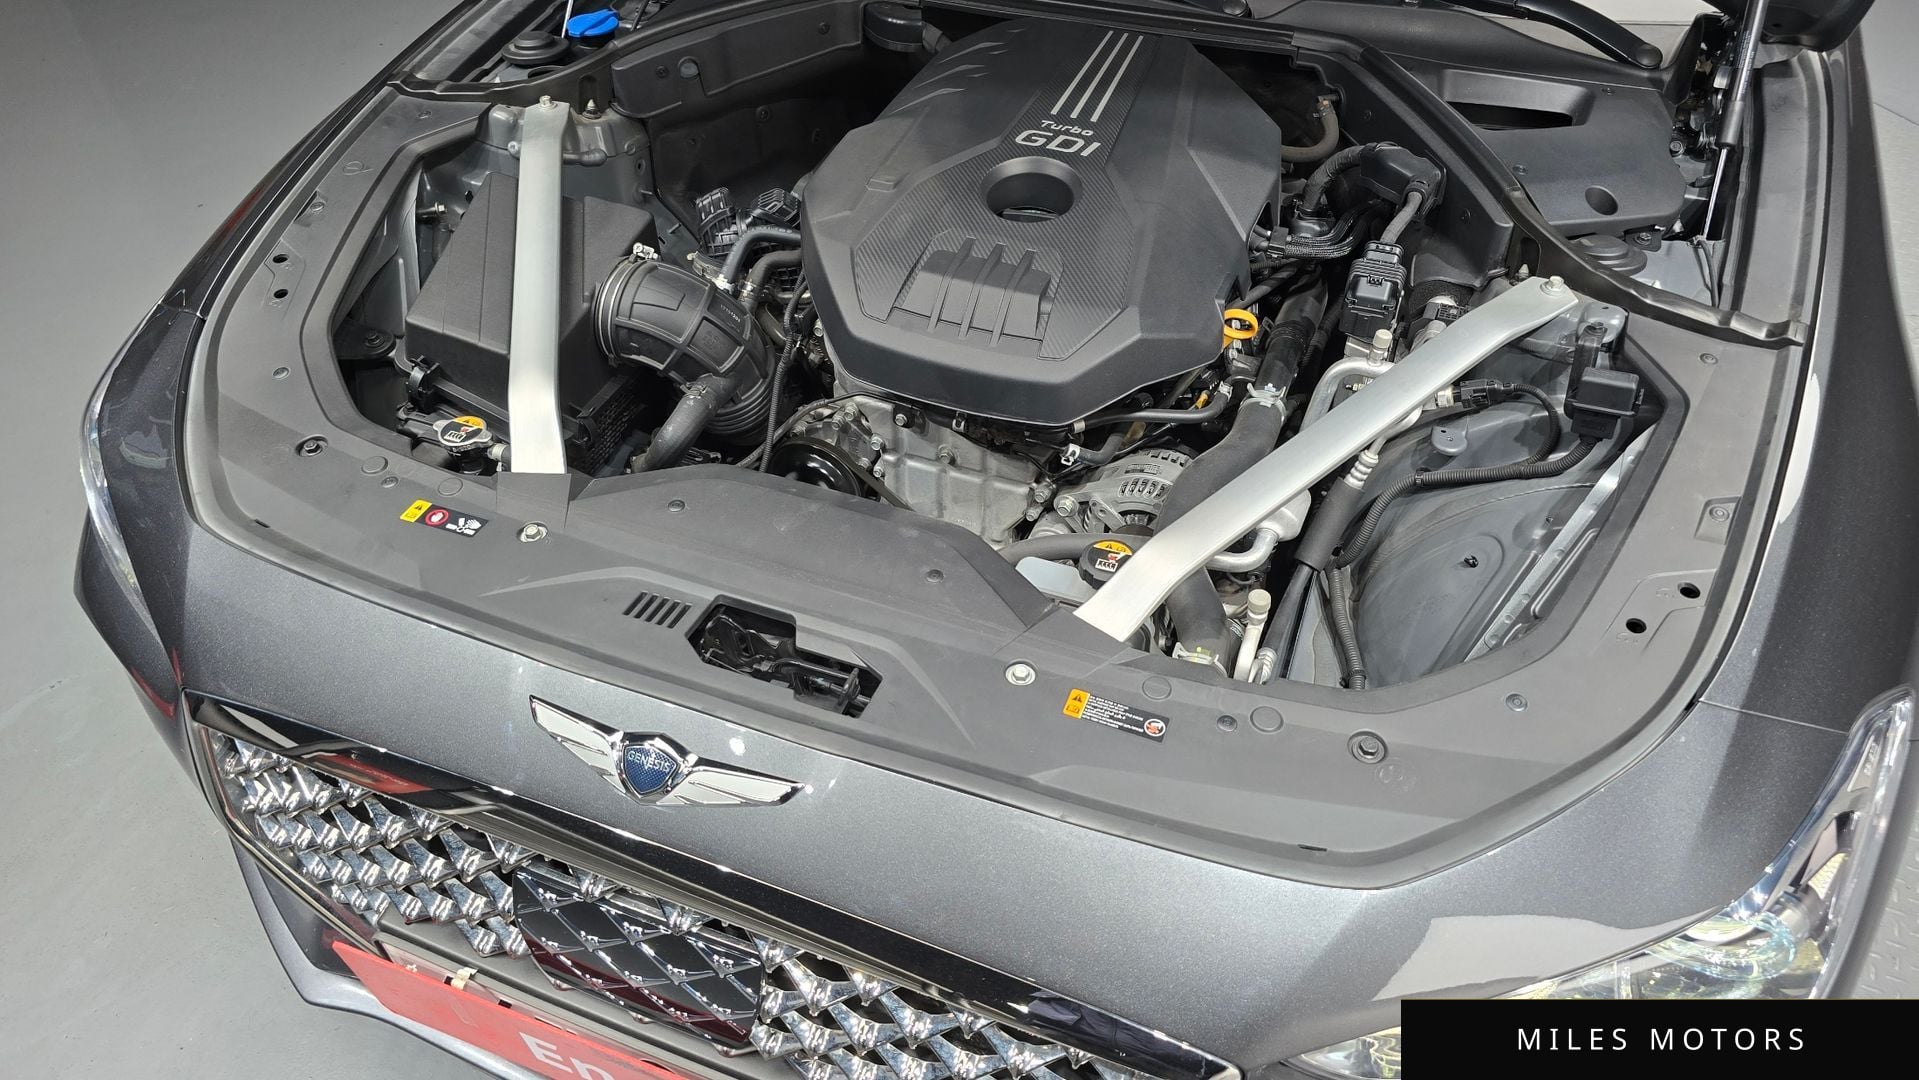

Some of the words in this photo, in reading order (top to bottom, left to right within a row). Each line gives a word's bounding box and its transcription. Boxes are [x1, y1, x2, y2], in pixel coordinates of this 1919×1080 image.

[1041, 120, 1094, 136] Turbo
[1015, 129, 1101, 156] GDI
[628, 750, 670, 773] GENESIS
